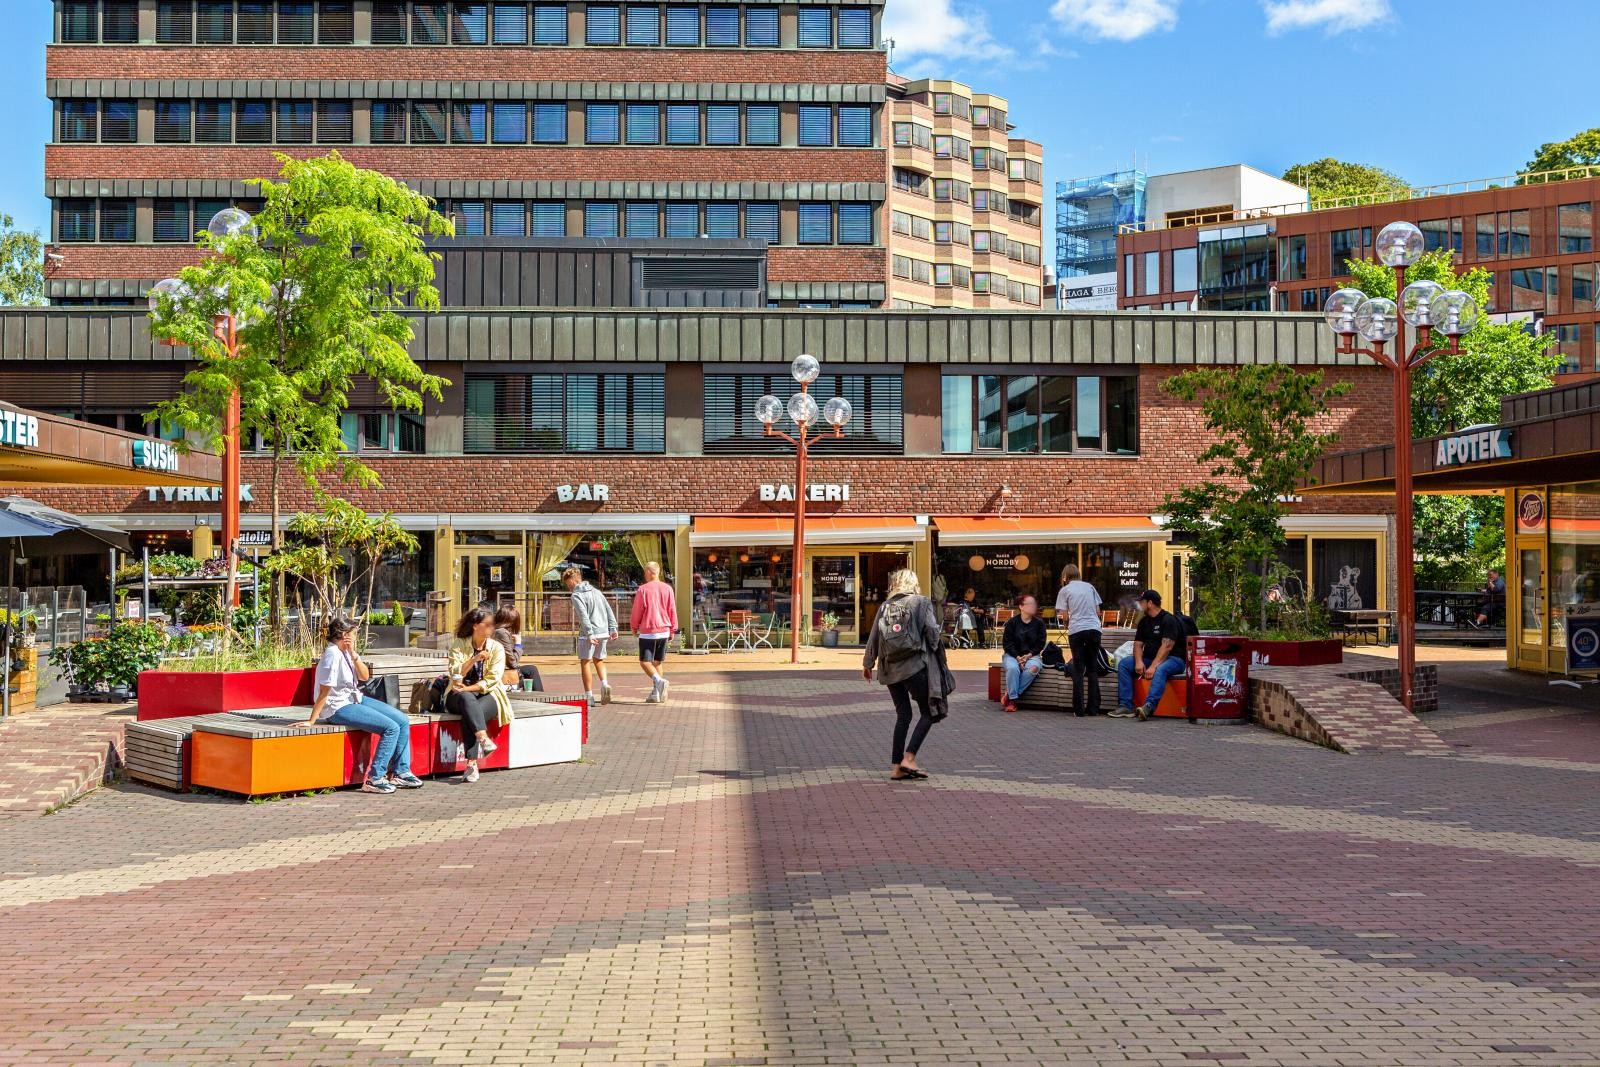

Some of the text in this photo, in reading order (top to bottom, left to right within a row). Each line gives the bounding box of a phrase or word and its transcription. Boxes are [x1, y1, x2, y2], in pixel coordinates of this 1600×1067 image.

[143, 440, 178, 471] SUSHI
[1436, 430, 1502, 466] APOTEK
[145, 485, 254, 502] TYRKIK
[556, 482, 609, 504] BAR
